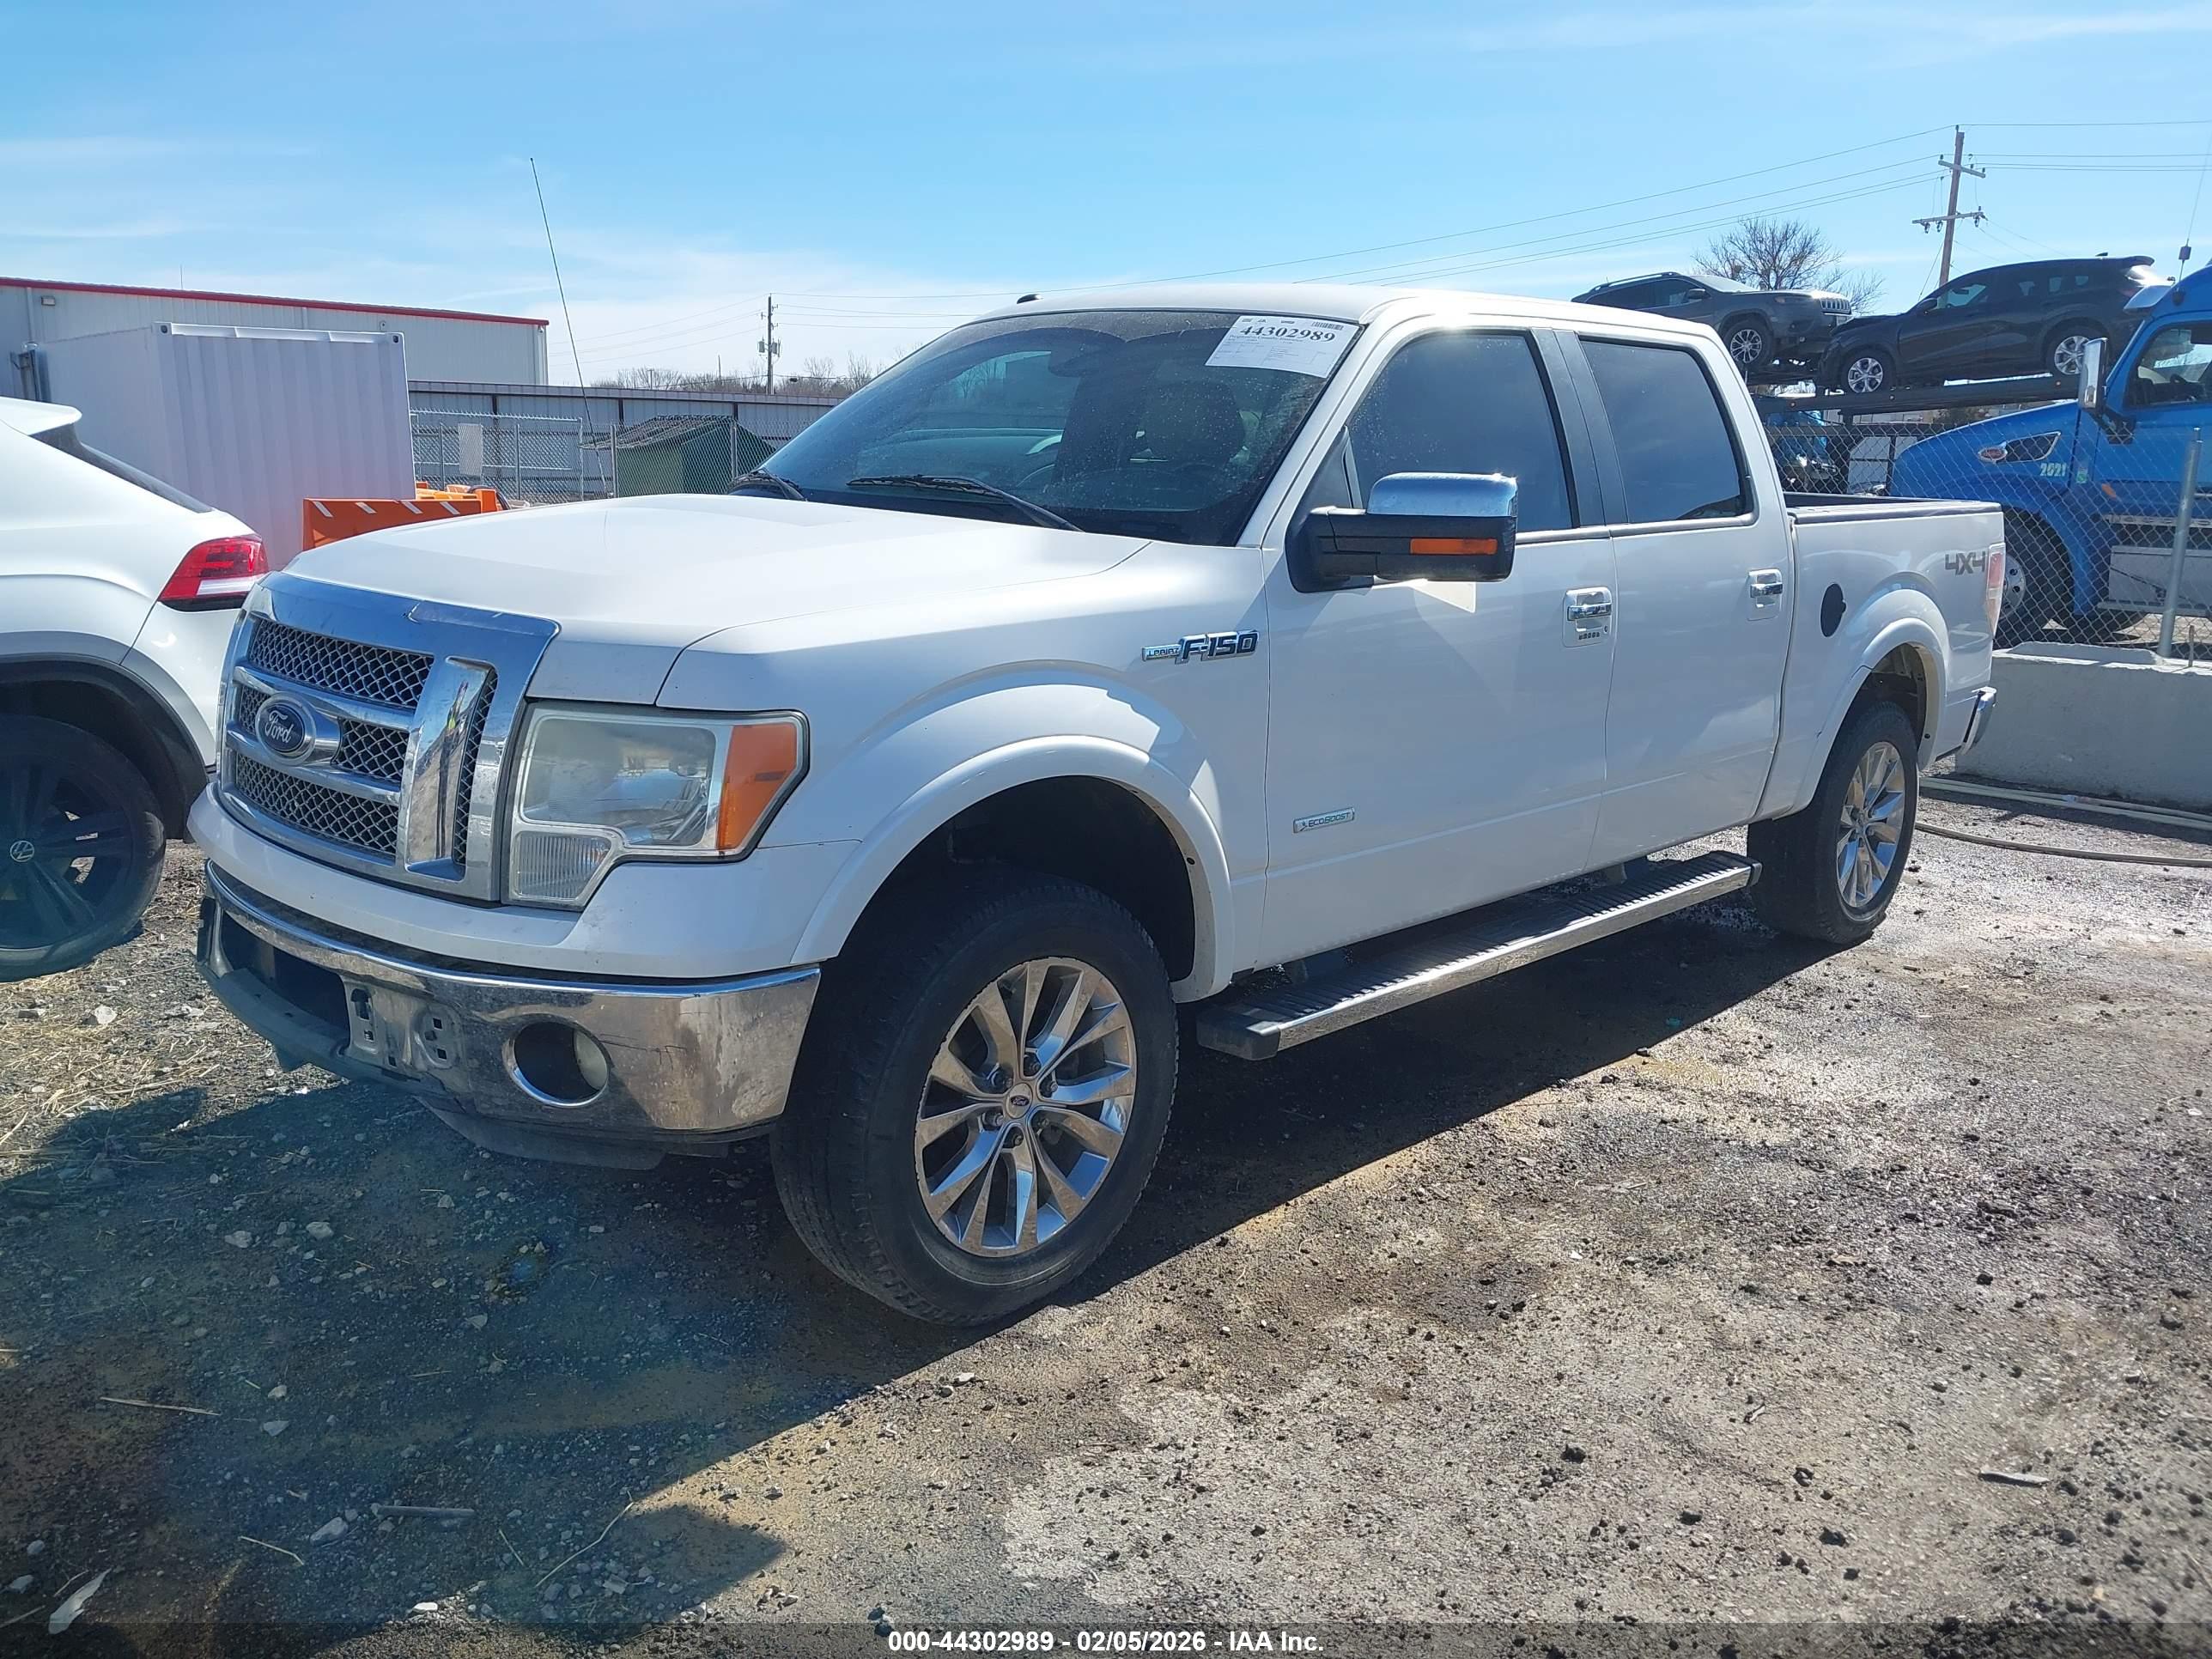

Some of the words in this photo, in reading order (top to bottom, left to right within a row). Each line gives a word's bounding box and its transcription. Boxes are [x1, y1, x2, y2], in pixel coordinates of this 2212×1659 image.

[1240, 325, 1336, 343] 44302989
[1944, 550, 1986, 575] 4X4
[1176, 630, 1260, 664] F-150
[264, 709, 295, 744] Ford
